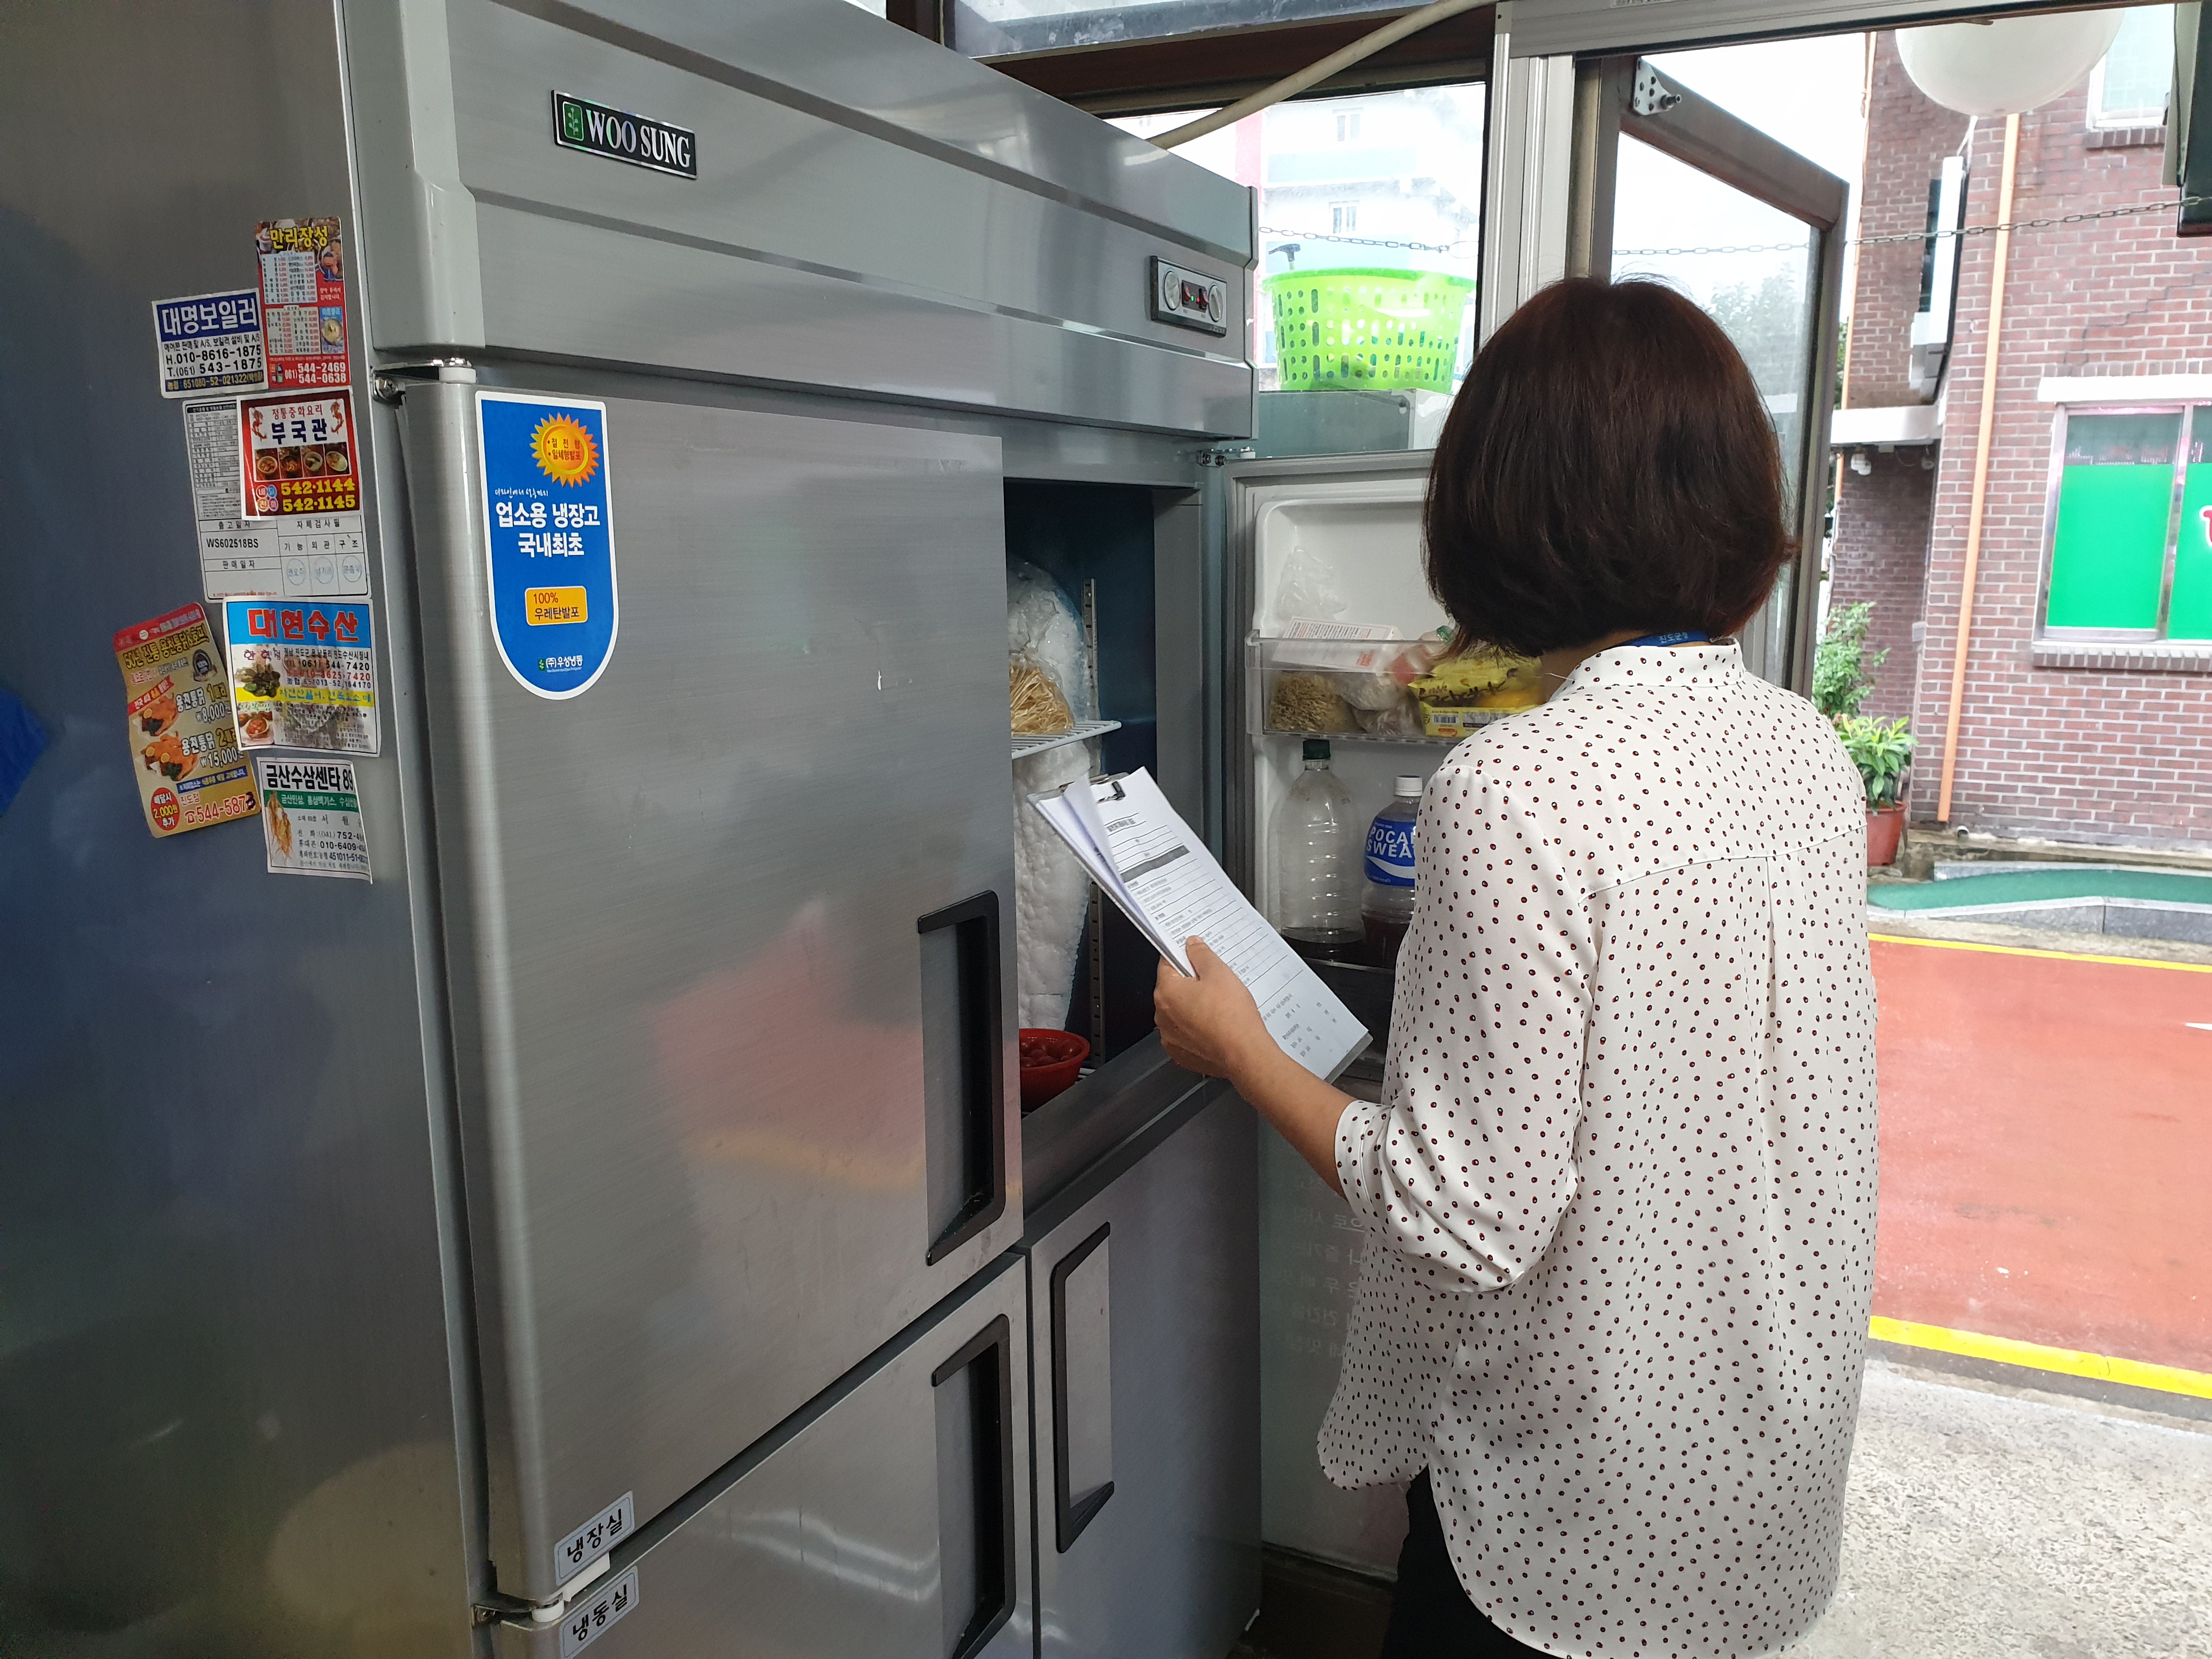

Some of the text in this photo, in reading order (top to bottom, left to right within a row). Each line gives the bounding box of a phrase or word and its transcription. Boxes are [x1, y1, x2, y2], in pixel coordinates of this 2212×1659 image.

[585, 109, 690, 167] WOO SUNG
[270, 225, 328, 249] 만리장성
[162, 298, 257, 335] 대명보일러
[213, 336, 230, 347] 보일러
[166, 344, 261, 365] H.010-8616-1875
[199, 357, 262, 375] 543-1875
[298, 362, 346, 374] 544-2469
[298, 373, 347, 383] 544-0638
[272, 404, 323, 420] 정통중화요리
[271, 418, 328, 445] 부국관
[551, 438, 580, 449] 절전형
[552, 449, 581, 461] 일체형발포
[496, 501, 601, 528] 업소용 냉장고
[206, 538, 259, 549] WS602518BS
[518, 532, 585, 558] 국내최초
[222, 560, 256, 568] 판매일자
[533, 592, 559, 604] 100%
[534, 606, 580, 620] 우레탄발포
[266, 765, 341, 791] 금산수삼센타
[342, 768, 354, 791] 89
[1366, 839, 1414, 858] SWEA
[567, 1509, 622, 1563] 냉장실
[573, 1584, 627, 1641] 냉동실
